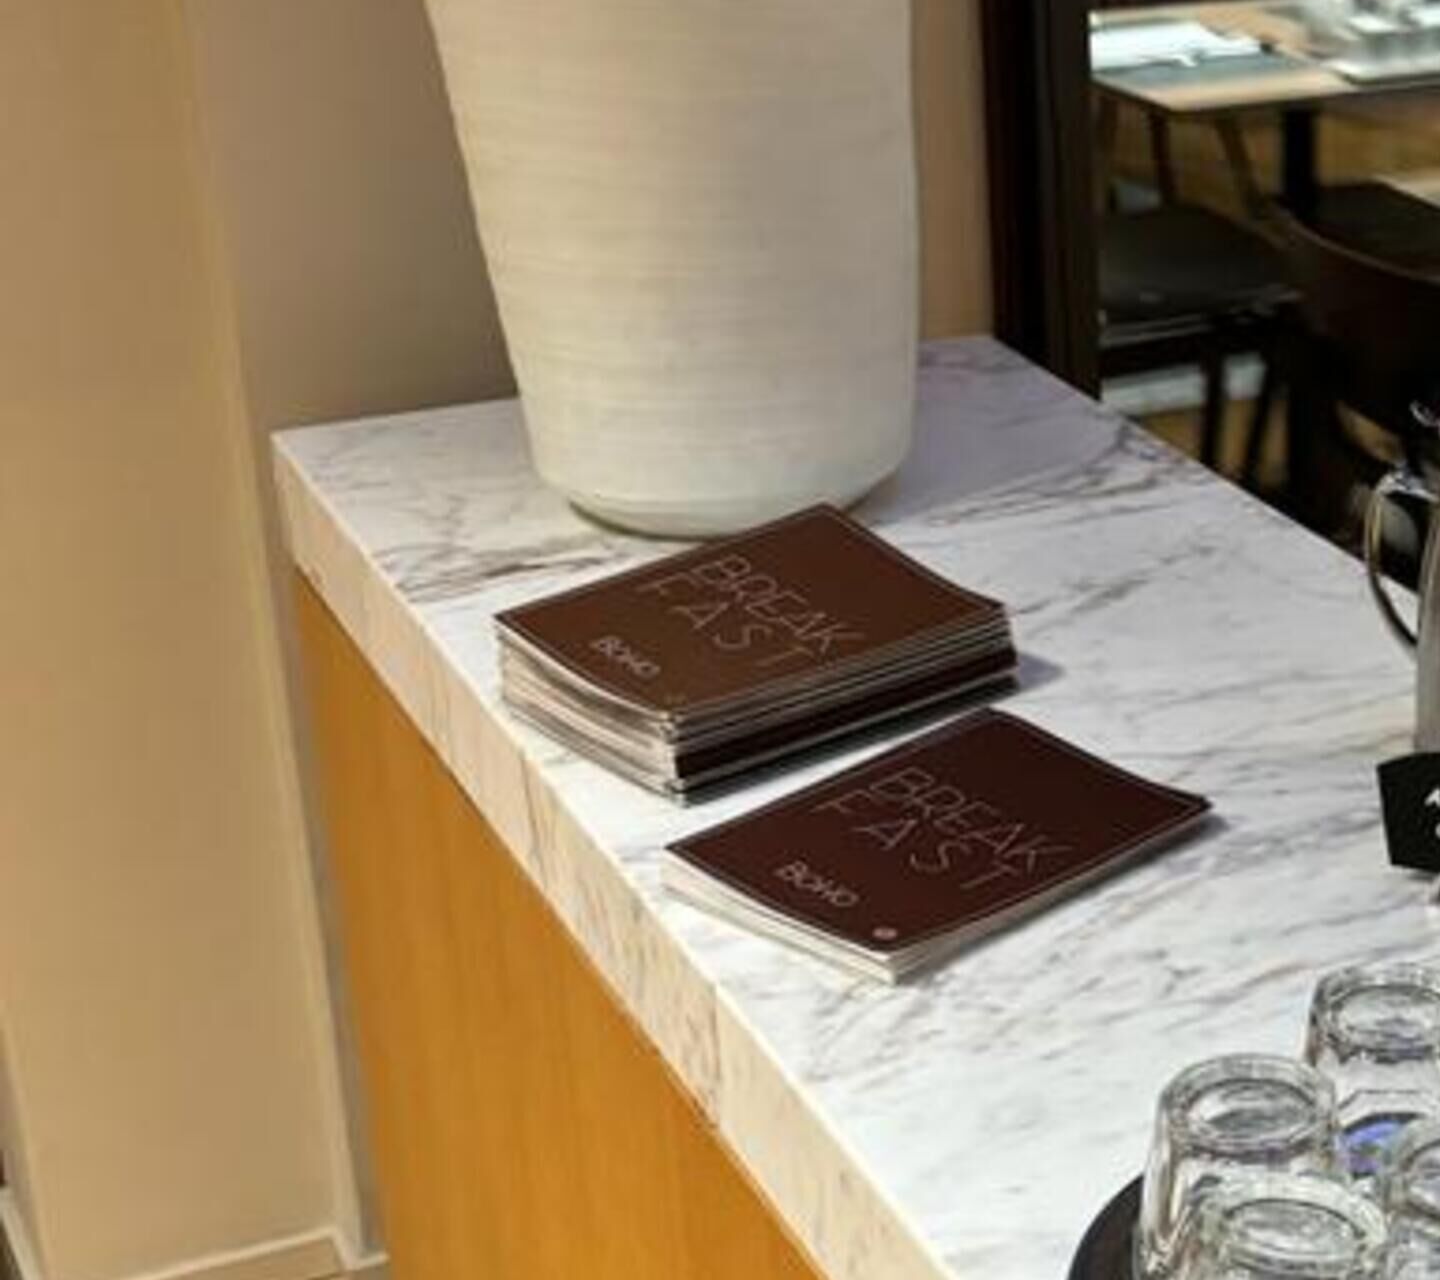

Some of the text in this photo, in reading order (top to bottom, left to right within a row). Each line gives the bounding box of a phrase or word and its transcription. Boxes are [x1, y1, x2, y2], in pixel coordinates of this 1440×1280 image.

[636, 572, 823, 668] FAST
[690, 554, 866, 657] BREAK
[810, 789, 1021, 890] FAST
[869, 767, 1074, 874] BREAK
[774, 860, 860, 908] BOHO
